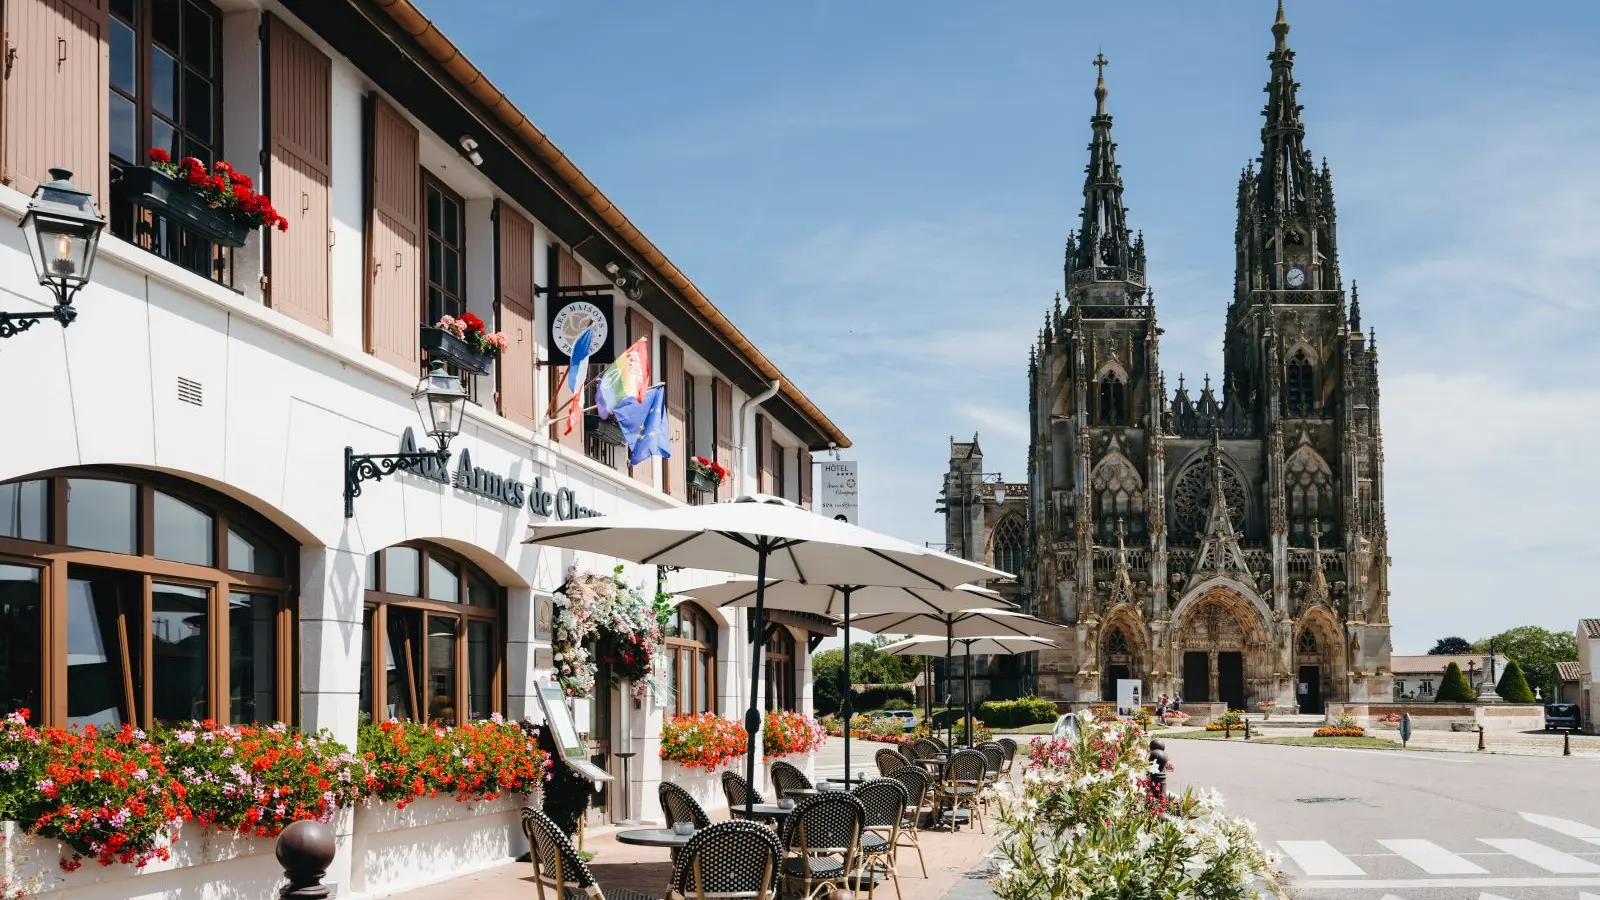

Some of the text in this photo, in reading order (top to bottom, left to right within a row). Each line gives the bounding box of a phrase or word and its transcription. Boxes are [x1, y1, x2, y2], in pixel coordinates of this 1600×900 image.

[555, 305, 604, 329] LES MAISONS
[399, 426, 450, 485] Aux
[456, 448, 525, 510] Armes
[530, 477, 553, 517] de
